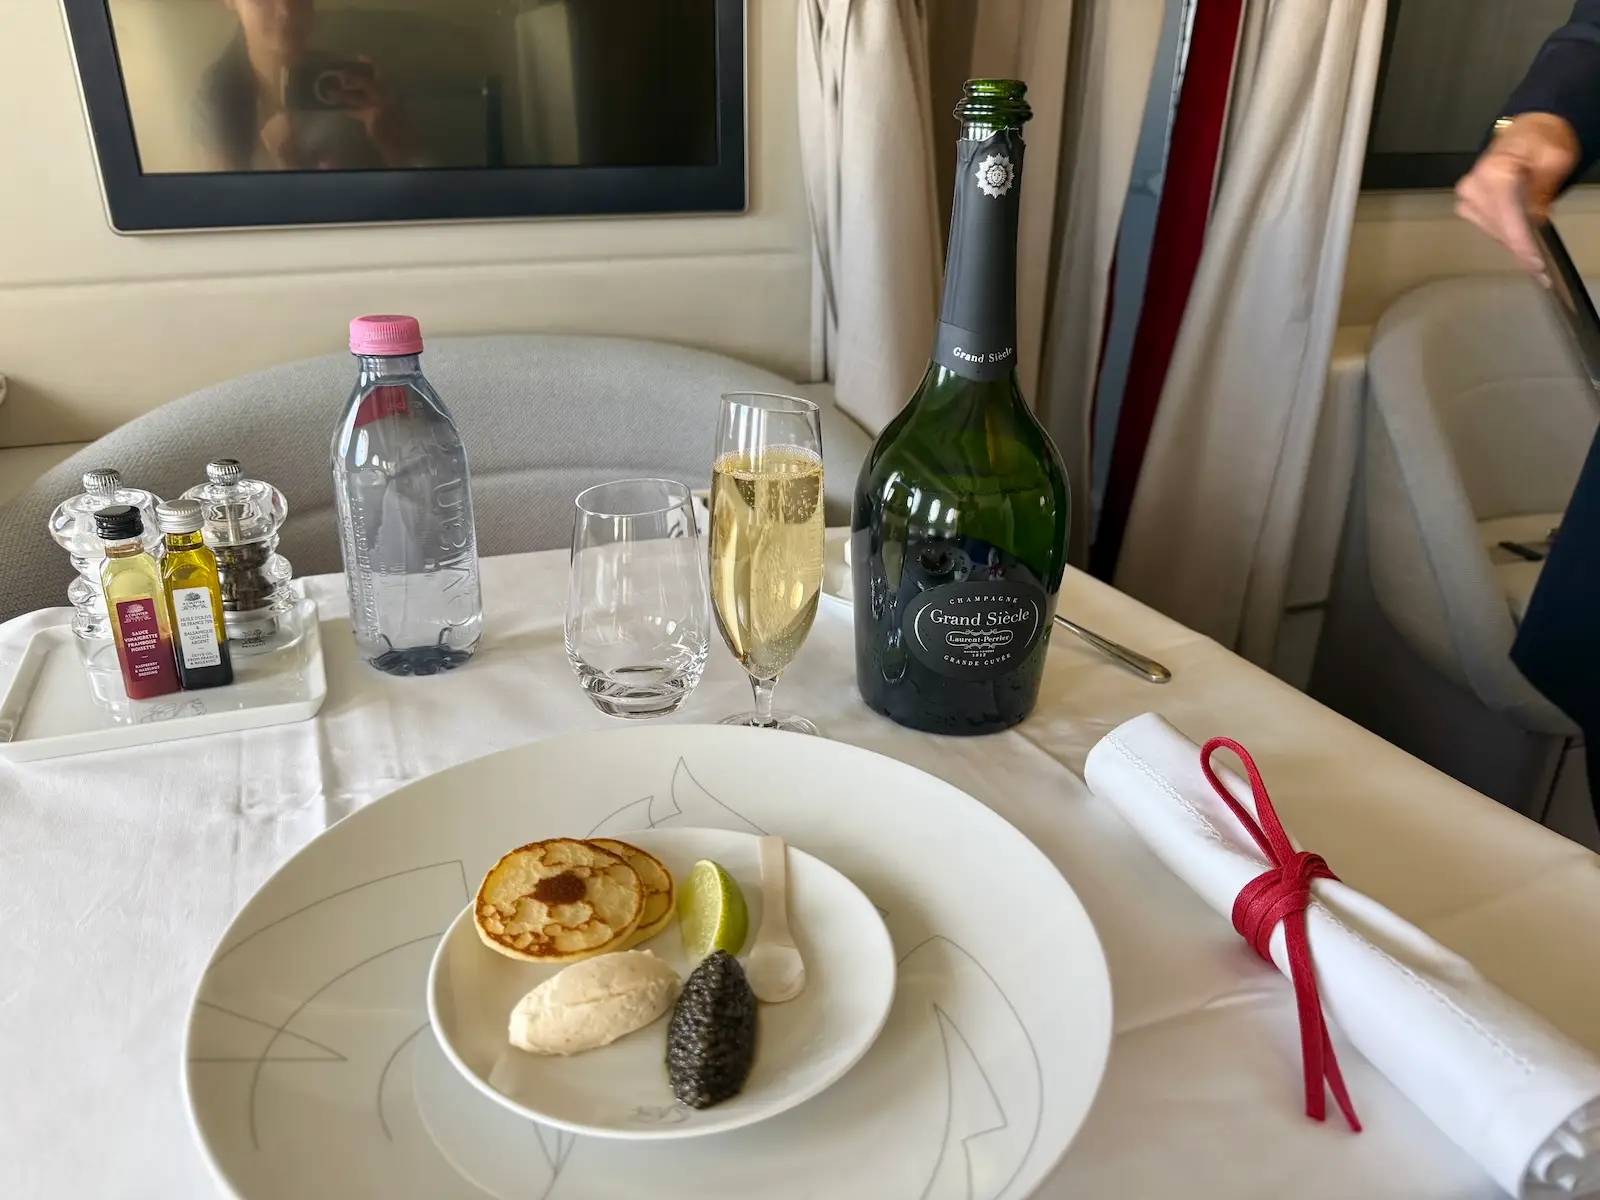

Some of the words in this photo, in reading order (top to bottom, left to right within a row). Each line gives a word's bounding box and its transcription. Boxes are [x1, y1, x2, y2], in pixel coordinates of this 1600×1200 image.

[953, 346, 985, 363] Grand
[988, 347, 1013, 363] Siècle
[949, 595, 1019, 605] CHAMPAGNE
[930, 609, 981, 626] Grand
[986, 608, 1029, 626] Siècle
[124, 633, 159, 642] VINAIGRETTE
[949, 634, 1010, 643] Laurent-Perrier
[127, 638, 157, 648] FRAMBOISE
[131, 644, 156, 652] NOISETTE
[943, 654, 980, 667] GRANDE
[984, 652, 1012, 666] CUVÉE
